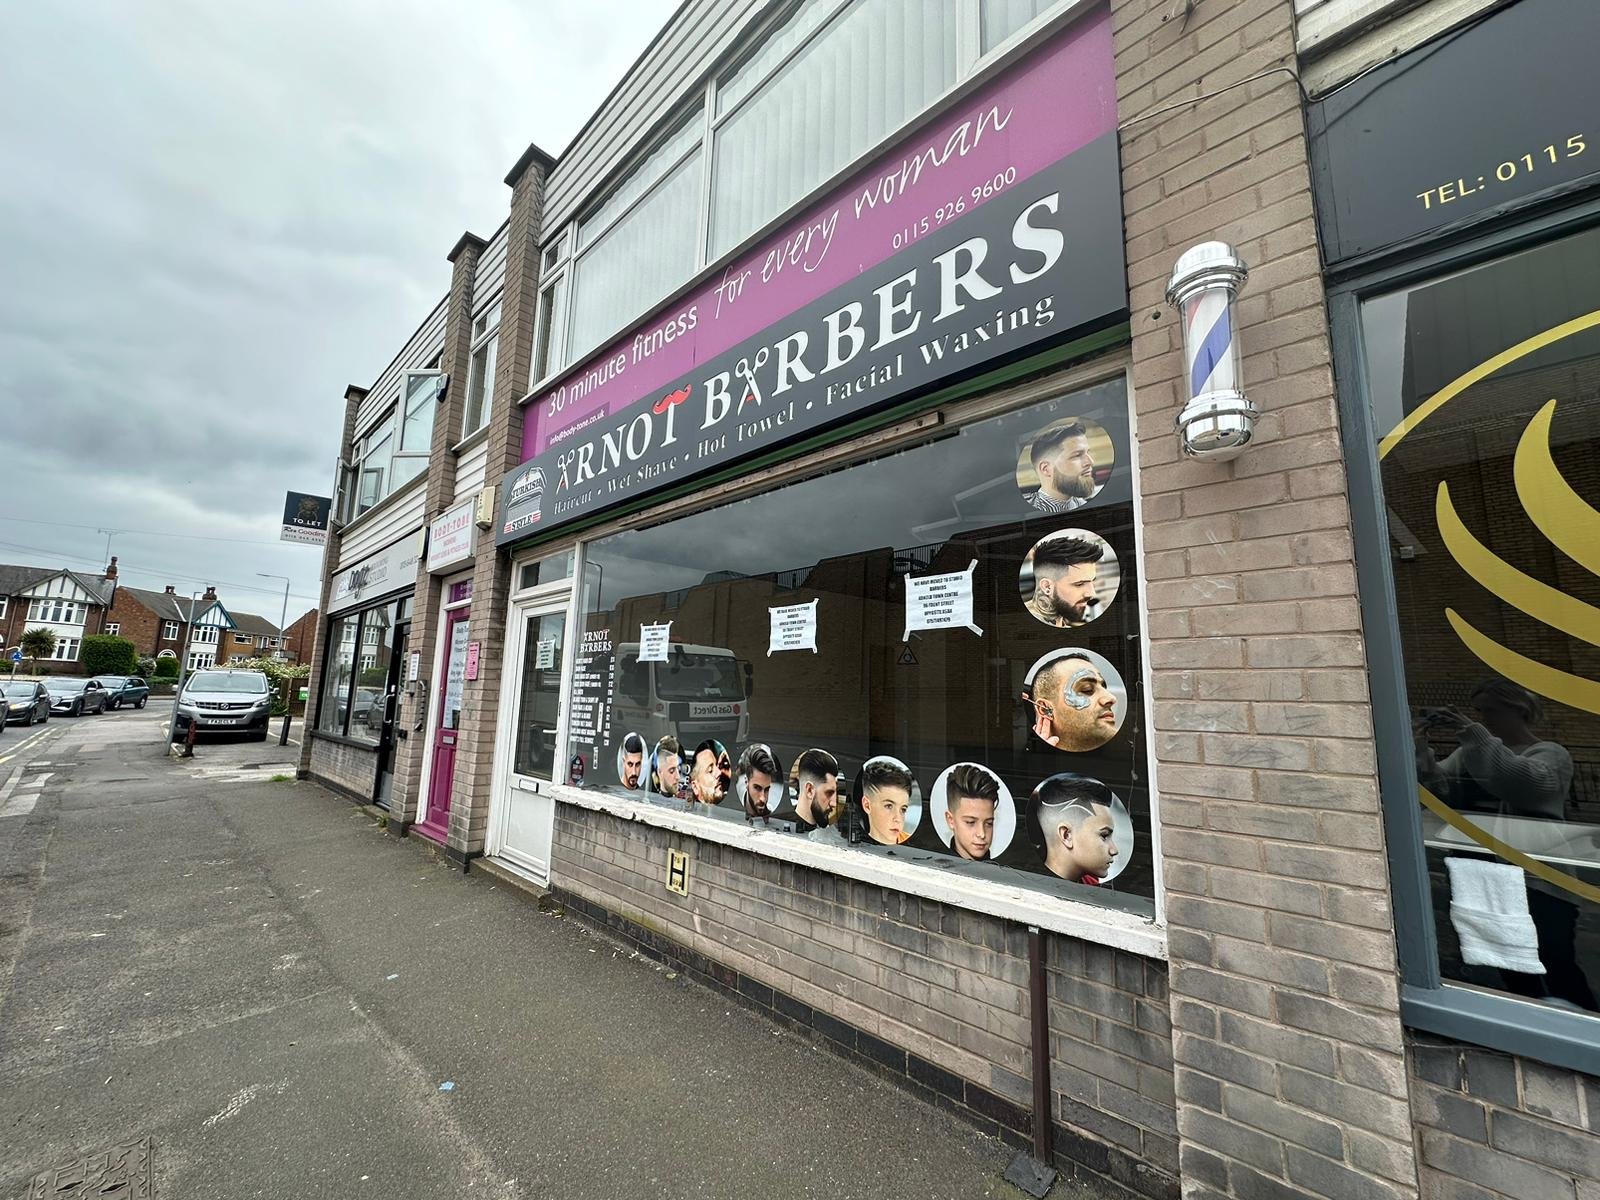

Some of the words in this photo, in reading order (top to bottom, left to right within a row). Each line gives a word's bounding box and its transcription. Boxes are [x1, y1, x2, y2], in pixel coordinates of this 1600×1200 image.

[893, 216, 929, 249] 0115
[935, 196, 965, 224] 926
[971, 166, 1016, 204] 9600
[1416, 176, 1486, 209] TEL:
[1496, 134, 1586, 182] 0115
[548, 385, 566, 418] 30
[569, 354, 626, 405] minute
[632, 305, 697, 365] fitness
[714, 265, 751, 319] for
[760, 209, 839, 273] every
[855, 104, 1016, 219] woman
[700, 192, 1064, 430] BARBERS
[554, 488, 592, 515] Haircut
[607, 473, 631, 493] Wet
[637, 455, 677, 483] Shave
[697, 434, 726, 458] Hot
[736, 401, 794, 442] Towel
[826, 354, 903, 406] Facial
[919, 295, 1055, 365] Waxing
[293, 517, 304, 525] TO
[306, 519, 322, 527] LET
[670, 852, 686, 891] H
